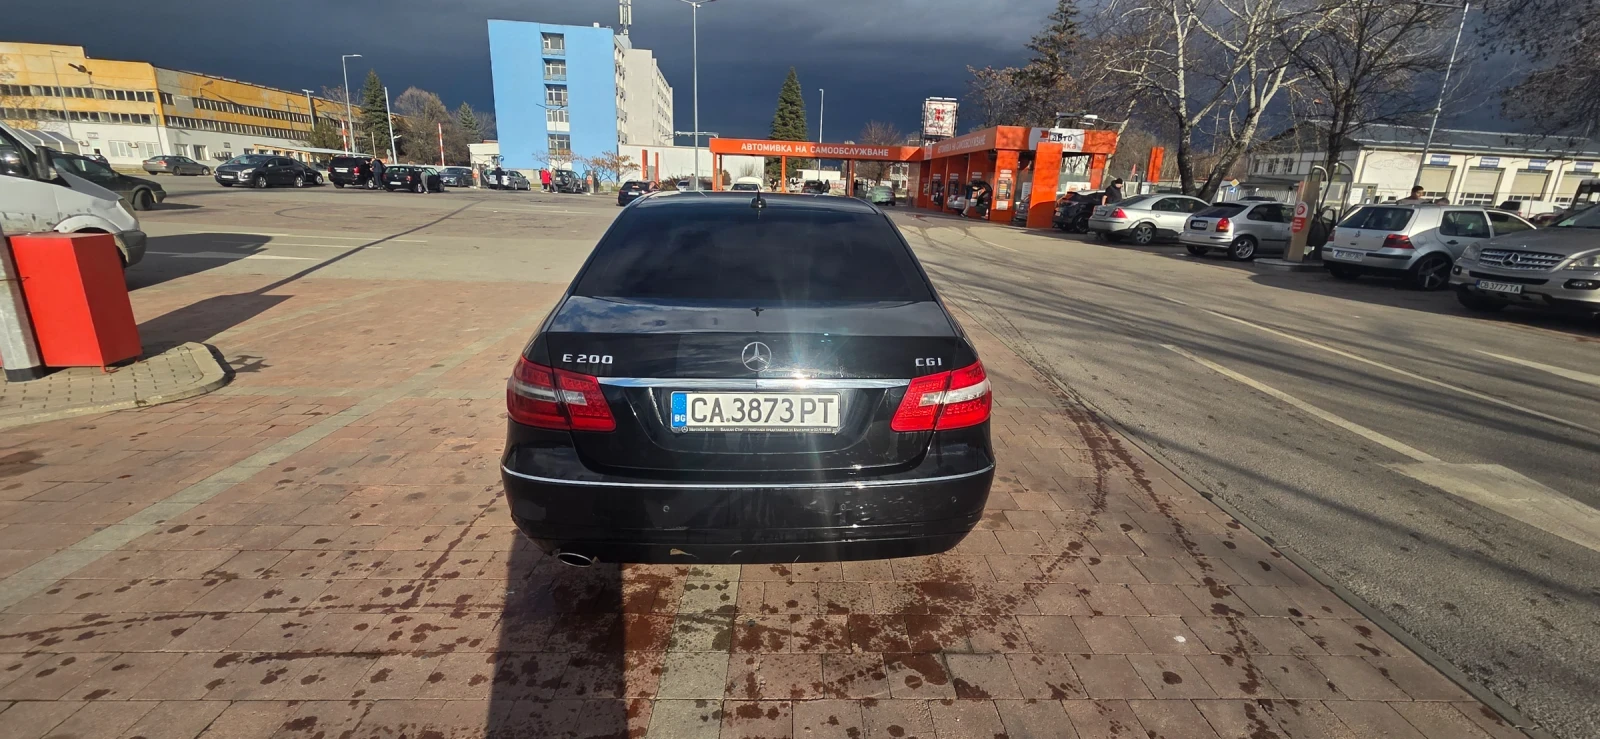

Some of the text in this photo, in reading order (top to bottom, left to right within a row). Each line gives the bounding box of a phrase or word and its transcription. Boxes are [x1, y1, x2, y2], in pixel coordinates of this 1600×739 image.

[741, 142, 889, 157] АВТОМИВКА НА САМООБСЛУЖВАНЕ
[562, 353, 613, 365] E 200
[915, 357, 942, 367] CGI
[674, 414, 686, 423] BG
